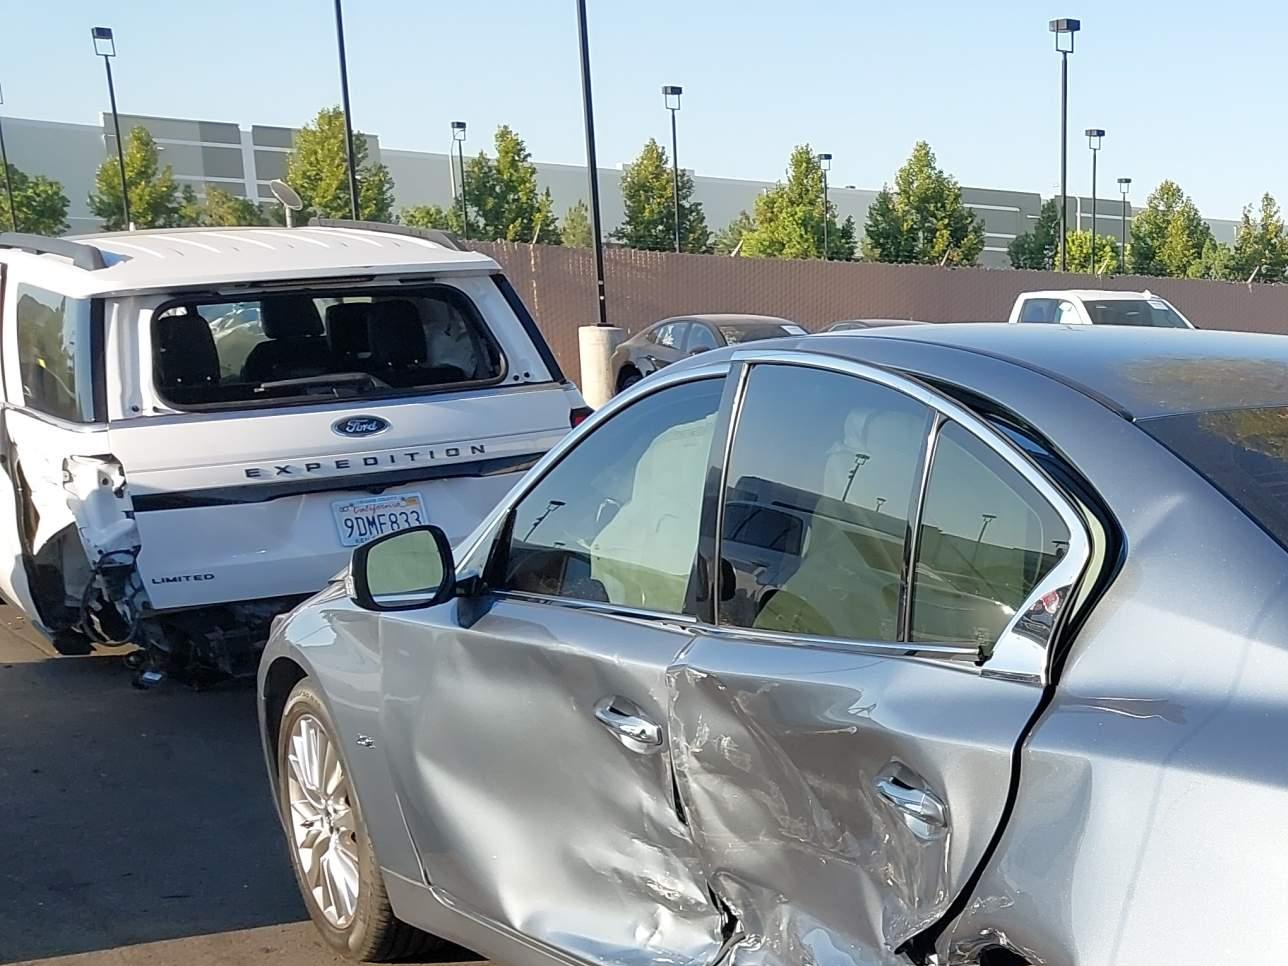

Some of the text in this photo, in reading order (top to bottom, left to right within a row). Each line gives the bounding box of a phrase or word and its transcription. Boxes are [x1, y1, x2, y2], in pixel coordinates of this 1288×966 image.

[346, 419, 378, 433] Ford
[245, 444, 486, 479] EXPEDITION
[343, 509, 422, 538] 9DMF833
[151, 573, 215, 585] LIMITED
